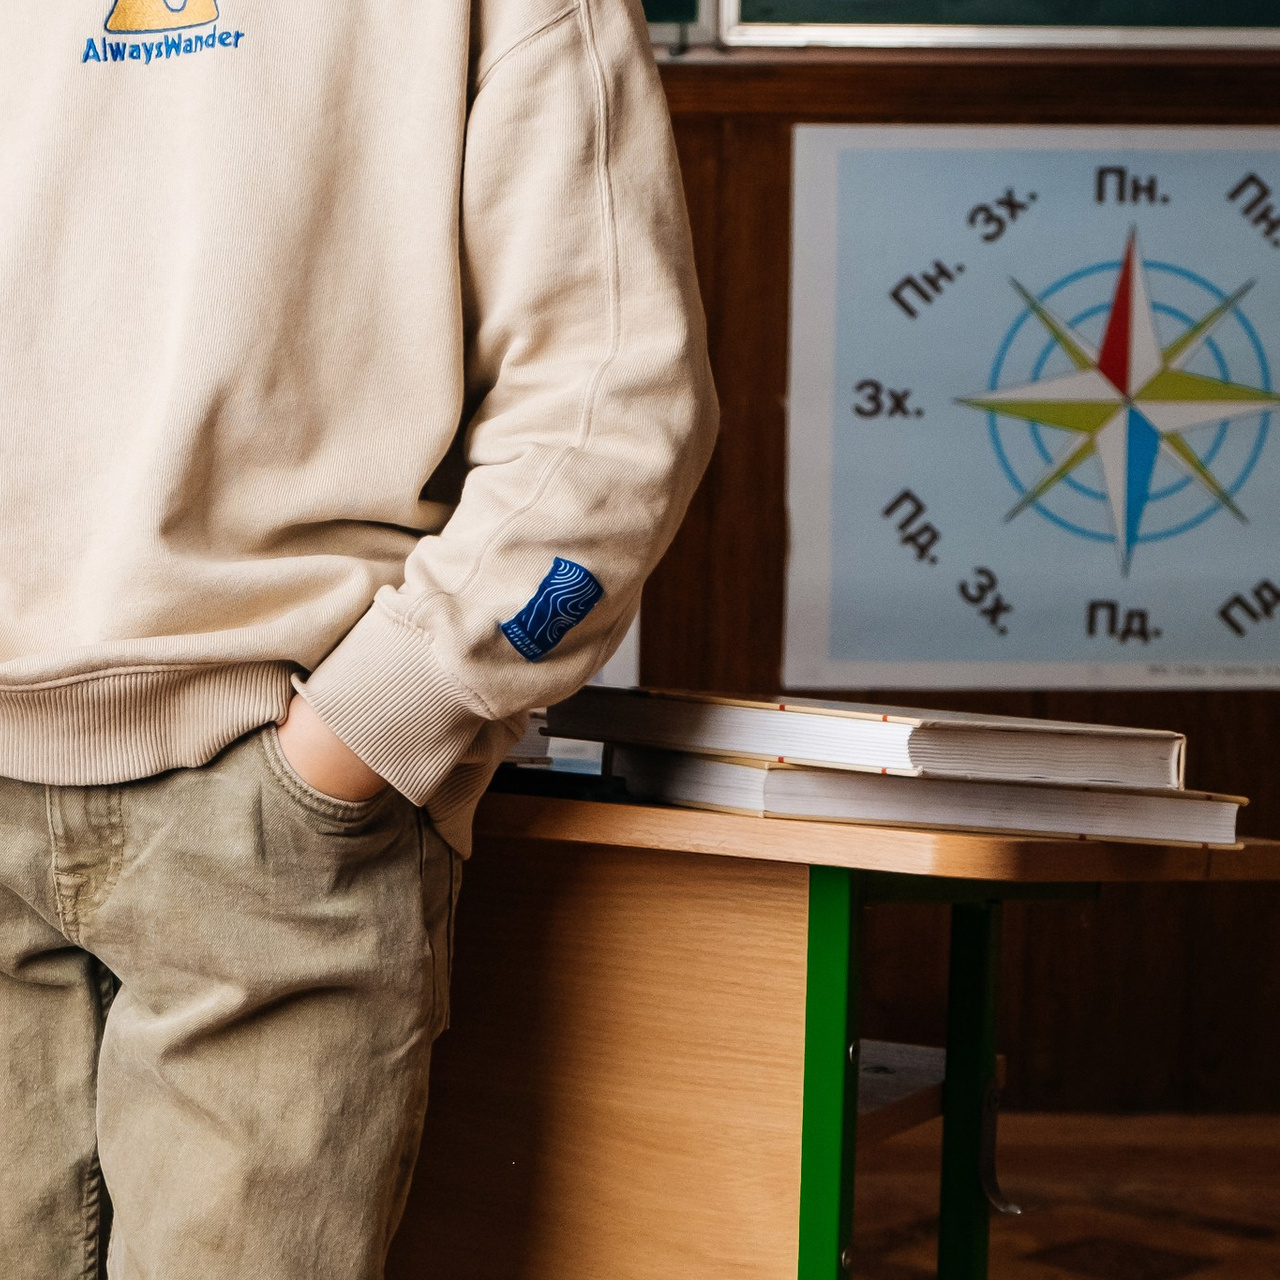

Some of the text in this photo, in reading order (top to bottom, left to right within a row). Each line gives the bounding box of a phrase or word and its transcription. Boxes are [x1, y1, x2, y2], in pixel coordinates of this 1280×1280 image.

[81, 25, 245, 65] AlwaysWander
[1093, 165, 1171, 204] Пн.
[888, 186, 1040, 320] Пн. Зх.
[851, 379, 925, 420] Зх.
[880, 487, 1014, 637] Пд. Зх.
[1084, 598, 1163, 646] Пд.
